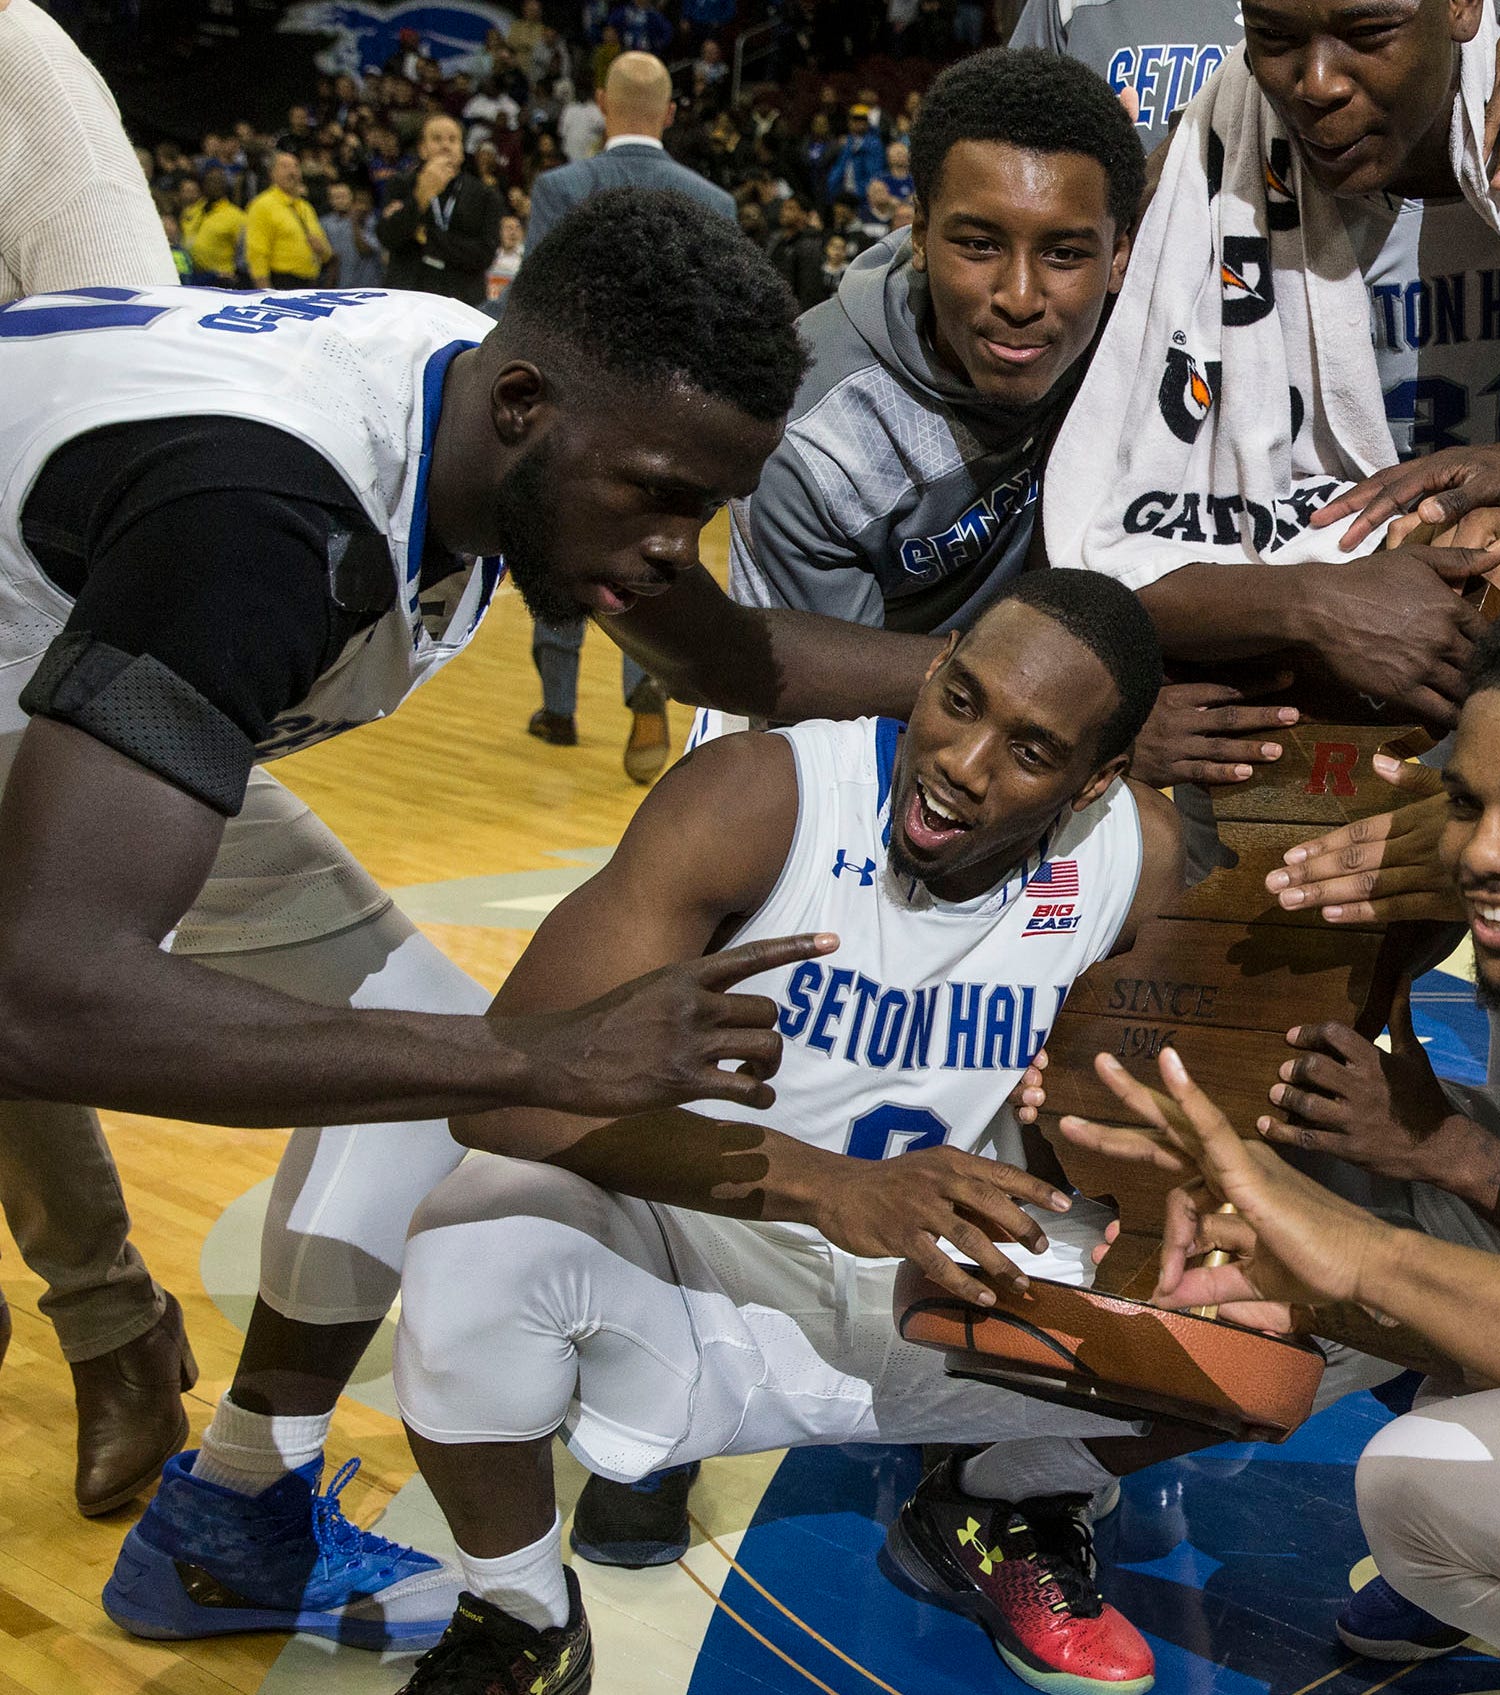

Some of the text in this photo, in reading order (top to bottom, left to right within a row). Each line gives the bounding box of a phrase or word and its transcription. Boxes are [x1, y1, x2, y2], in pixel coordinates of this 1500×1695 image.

[1302, 740, 1360, 798] R
[1025, 914, 1082, 931] EAST
[1032, 903, 1076, 918] BIG
[777, 959, 942, 1072] SETON
[1108, 977, 1219, 1019] SINCE
[1117, 1025, 1178, 1060] 1916
